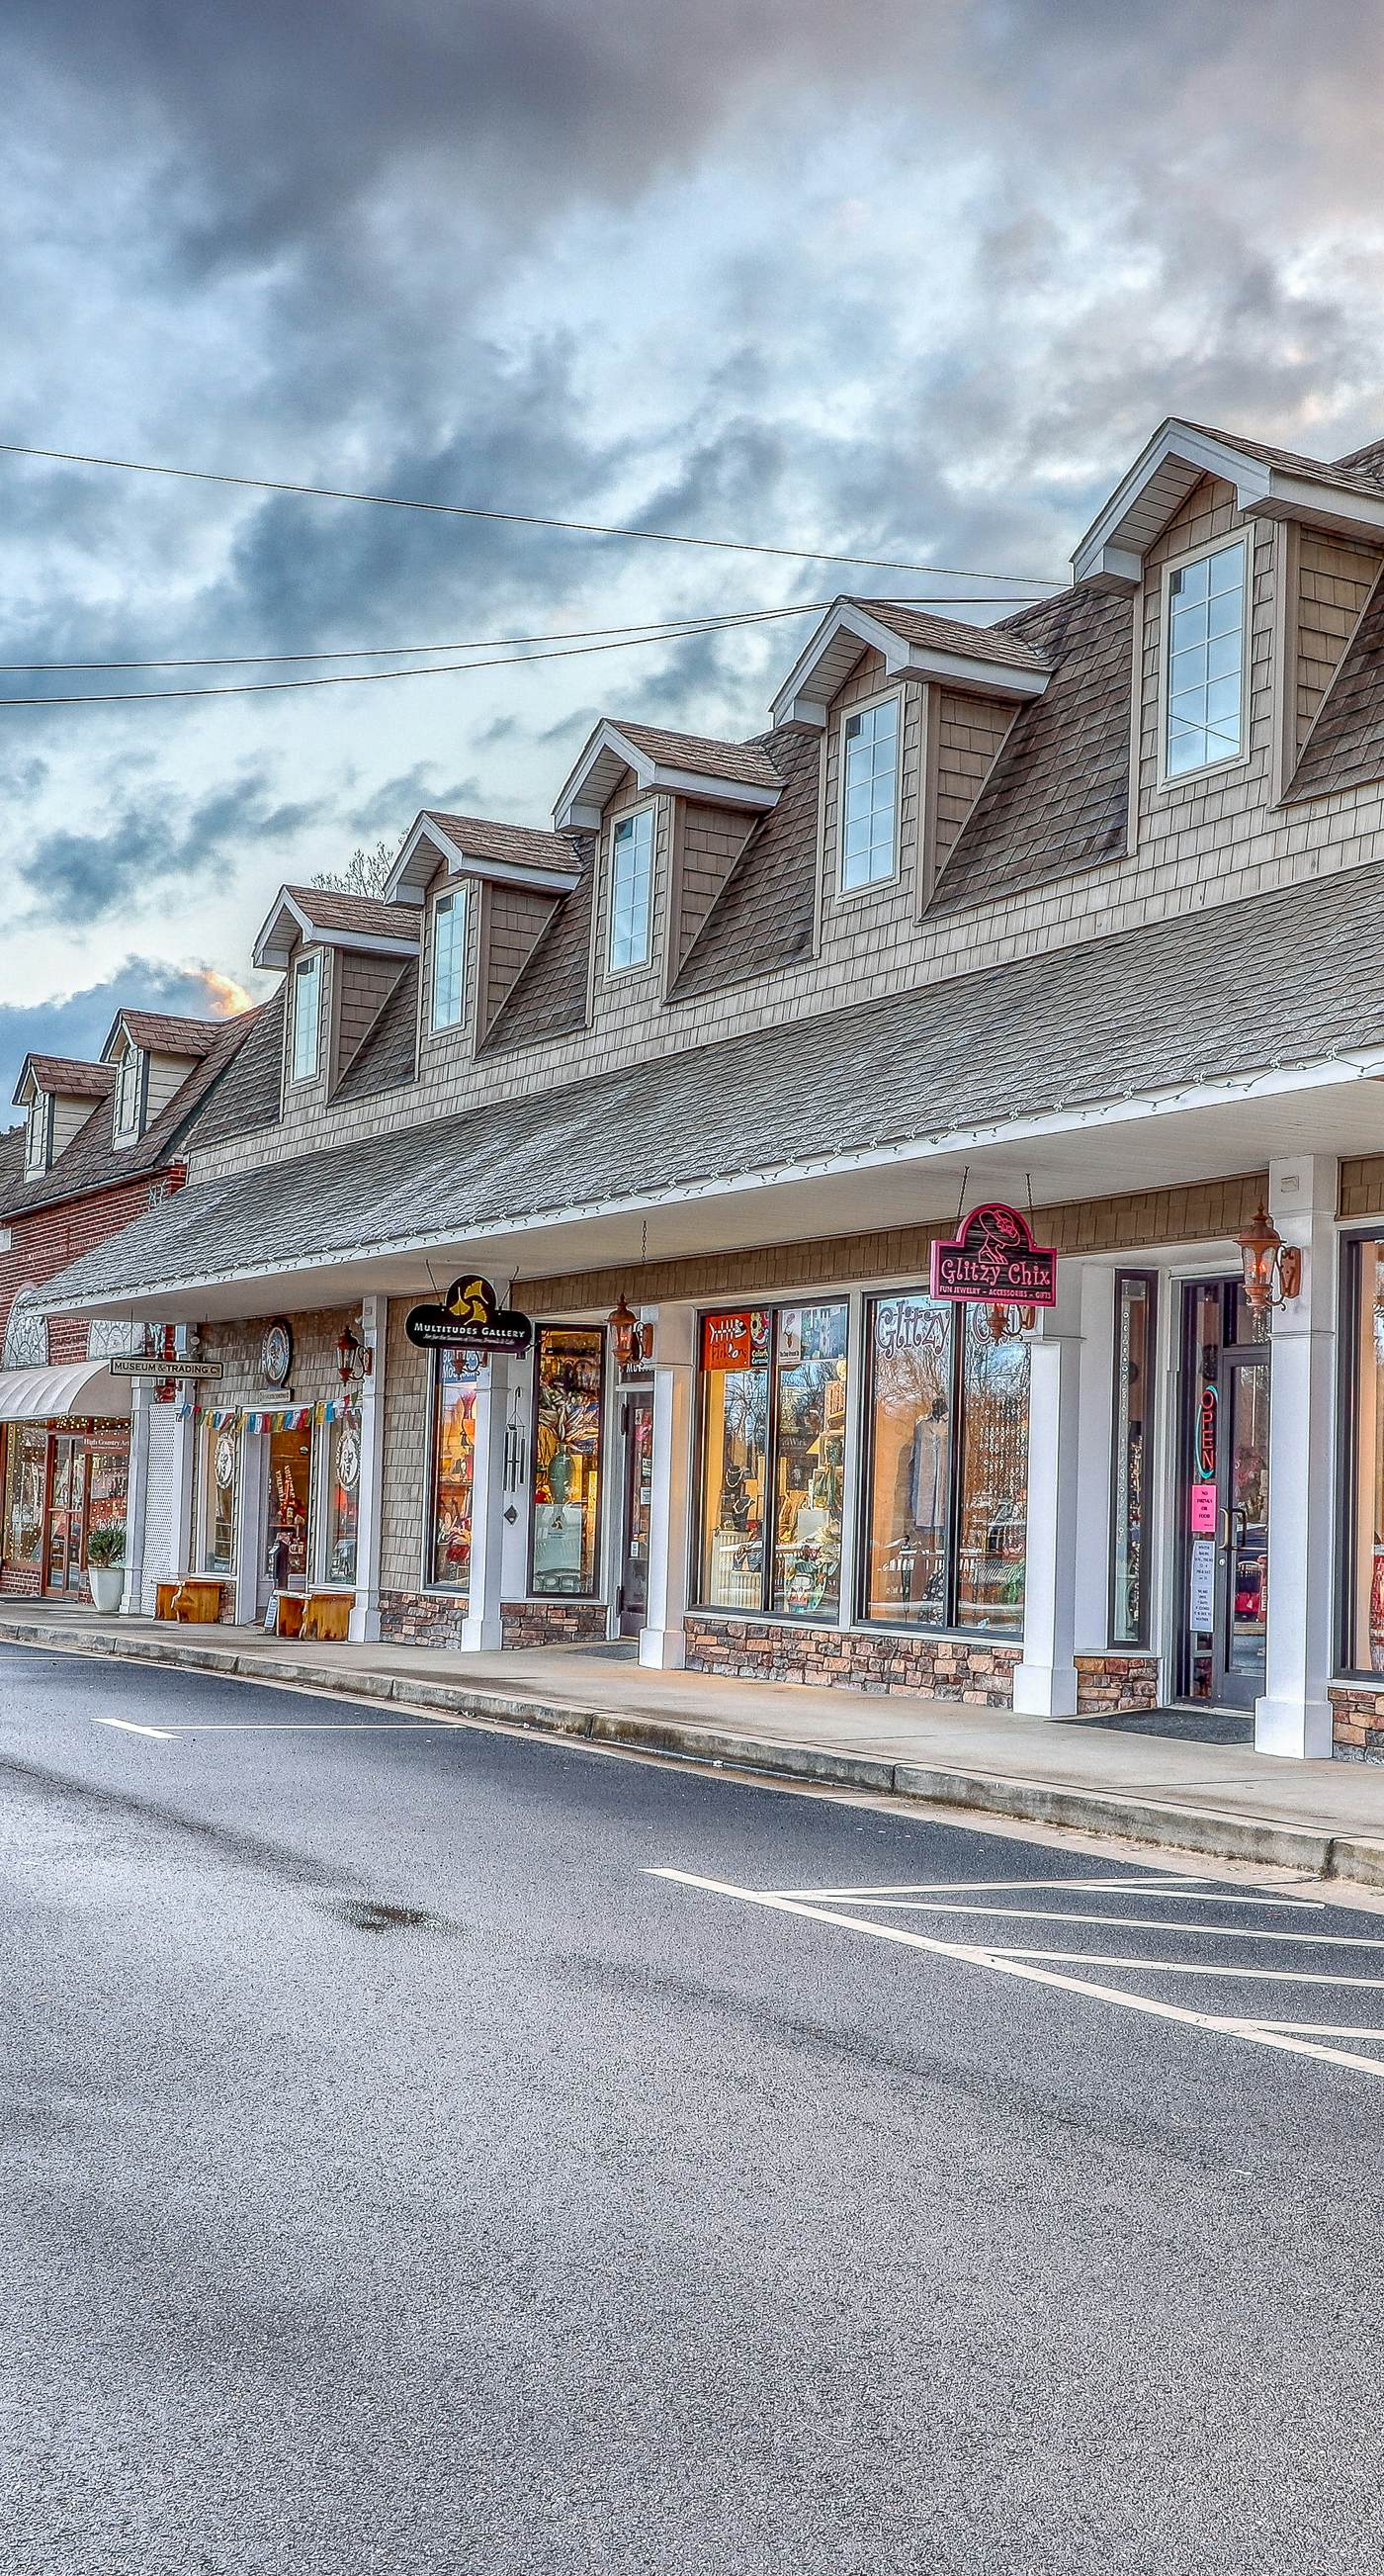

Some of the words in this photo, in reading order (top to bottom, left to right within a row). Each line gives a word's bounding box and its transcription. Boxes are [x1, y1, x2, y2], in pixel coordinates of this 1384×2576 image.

[941, 1258, 1000, 1287] Glitzy
[1008, 1261, 1051, 1286] Chix
[939, 1286, 954, 1294] FUN
[954, 1287, 981, 1295] JEWELRY
[989, 1288, 1027, 1297] ACCESSORIES
[414, 1322, 477, 1335] MULTITUDES
[481, 1327, 526, 1338] GALLERY
[875, 1299, 950, 1361] Glitzy
[115, 1362, 156, 1372] MUSEUM
[166, 1365, 208, 1374] TRADING
[1201, 1391, 1214, 1469] OPEN
